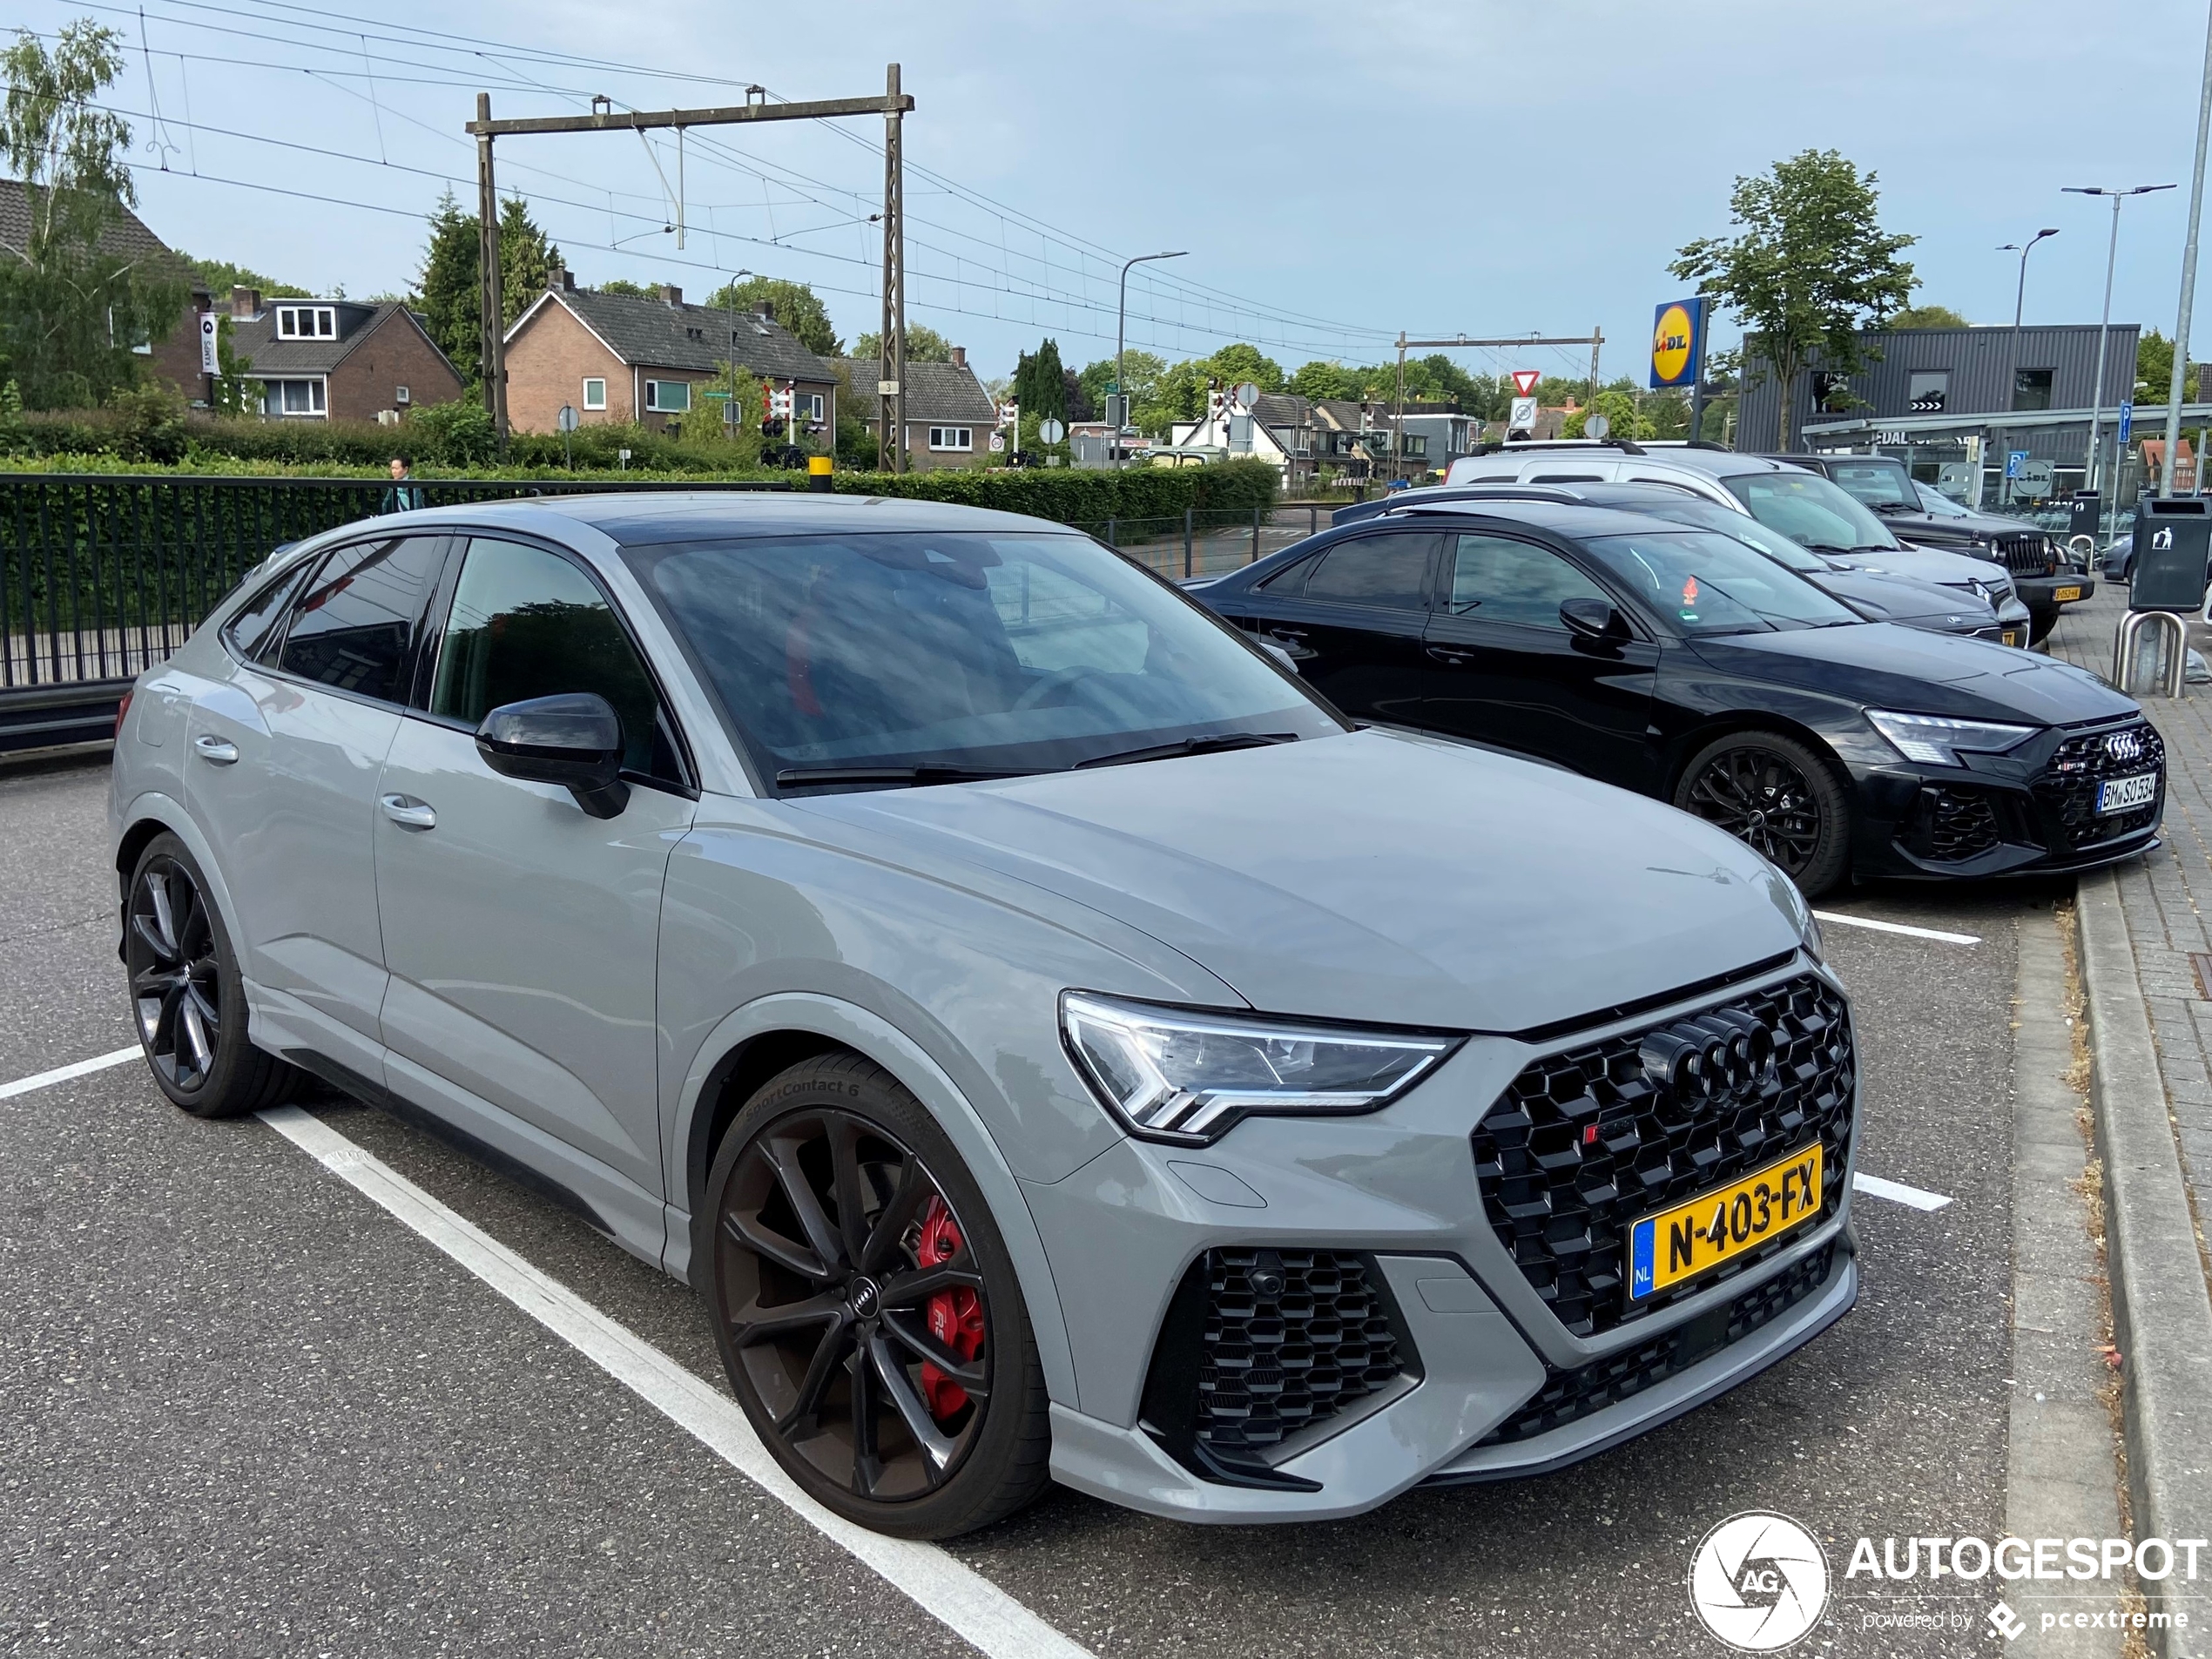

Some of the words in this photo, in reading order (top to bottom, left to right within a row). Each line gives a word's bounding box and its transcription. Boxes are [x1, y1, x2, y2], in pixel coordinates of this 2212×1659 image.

[203, 340, 212, 367] KAMPS
[886, 383, 892, 392] 3
[2123, 407, 2130, 426] P
[2103, 785, 2120, 808] BM
[2137, 775, 2155, 800] 534
[745, 1079, 844, 1120] SportContact
[848, 1083, 860, 1096] 6
[1669, 1158, 1815, 1273] N-403-FX
[1635, 1265, 1650, 1285] NL
